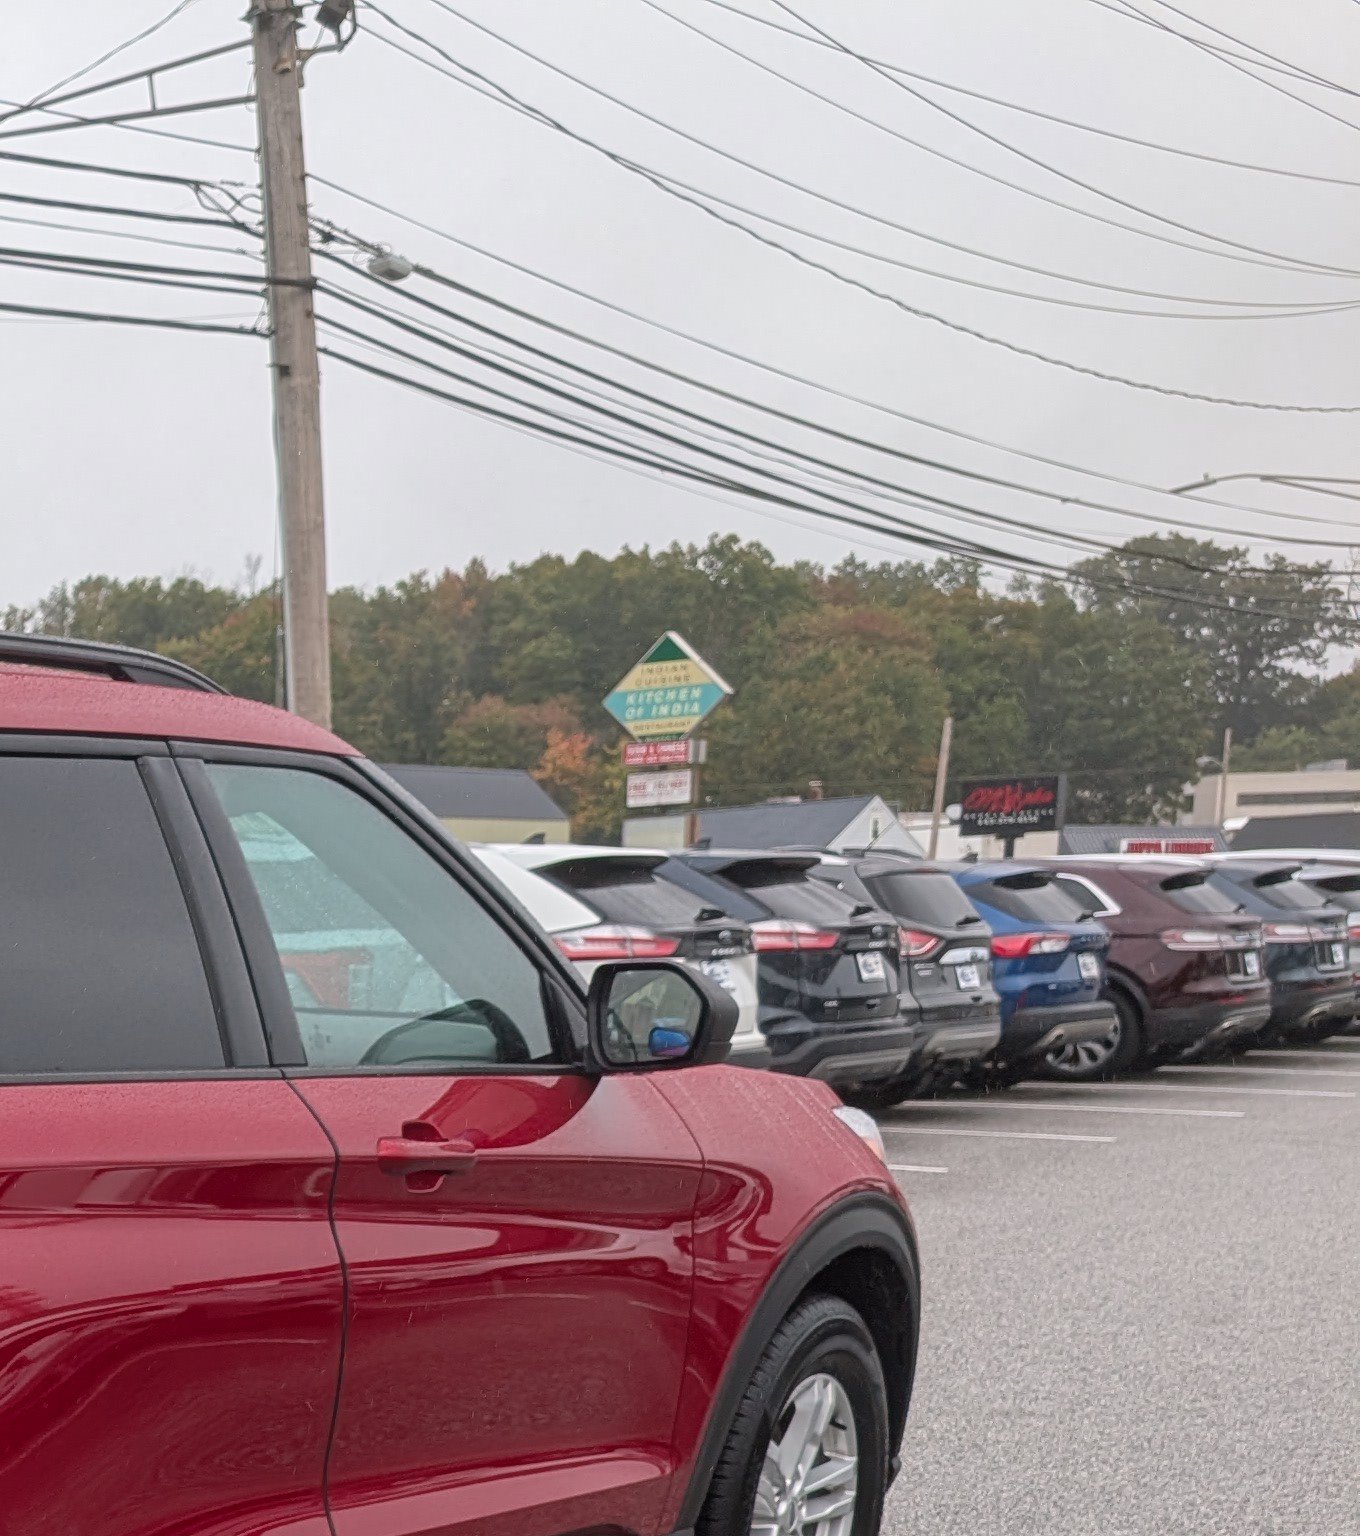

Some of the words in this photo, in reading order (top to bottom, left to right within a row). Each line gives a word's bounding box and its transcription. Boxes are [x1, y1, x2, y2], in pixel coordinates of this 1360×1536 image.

[641, 664, 687, 674] INDIAN
[625, 687, 701, 704] KITCHEN
[625, 706, 645, 720] OF
[651, 702, 699, 717] INDIA
